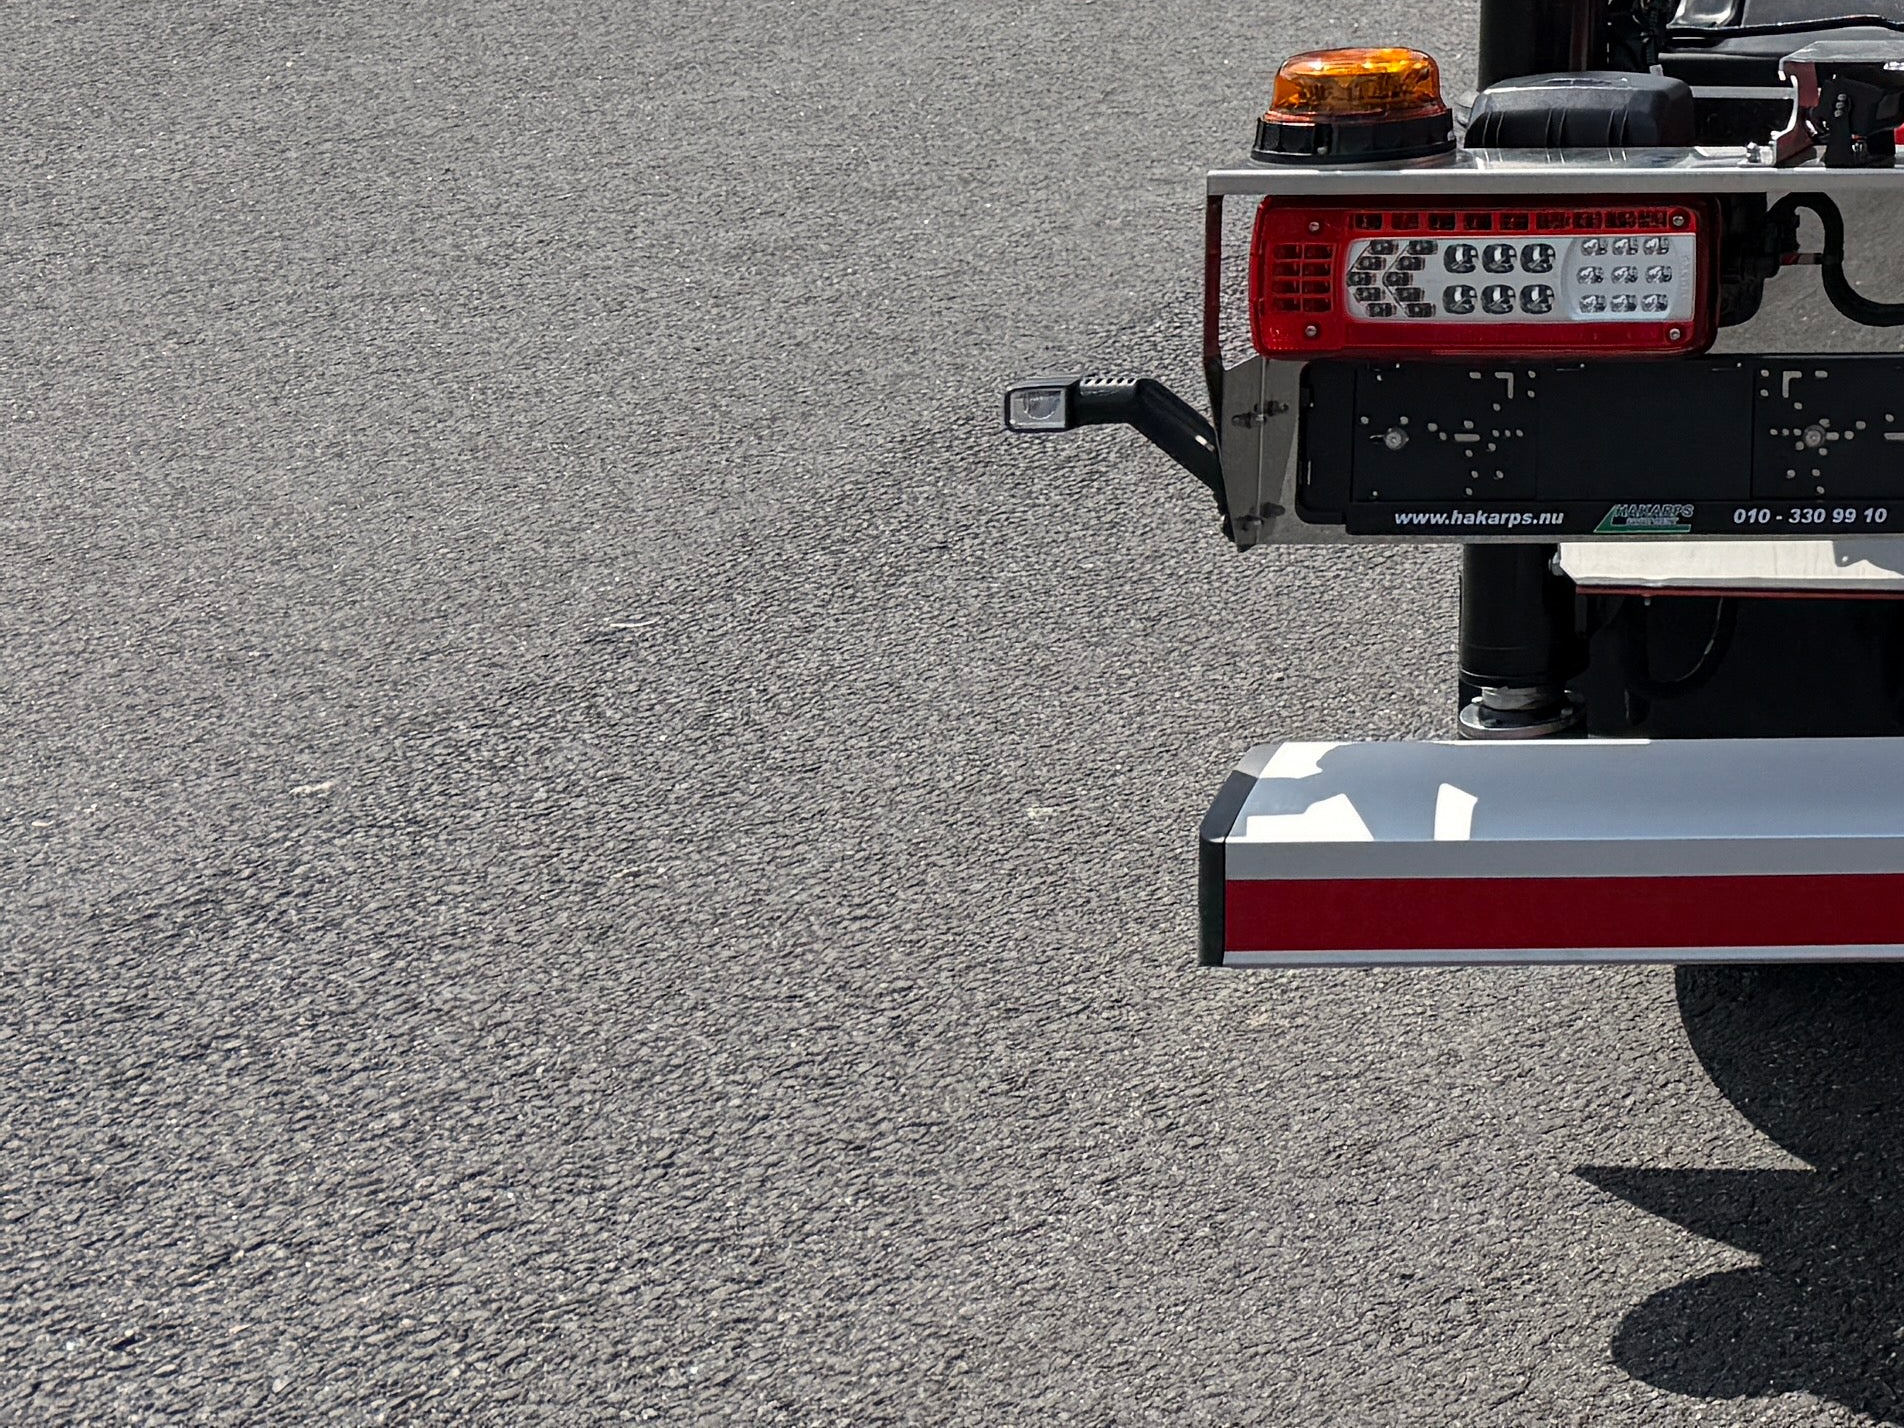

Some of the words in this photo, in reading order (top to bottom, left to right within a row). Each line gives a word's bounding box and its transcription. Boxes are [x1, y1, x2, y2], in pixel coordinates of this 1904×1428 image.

[1395, 509, 1565, 528] www.hakarps.nu
[1614, 504, 1695, 518] HAKARPS
[1733, 508, 1771, 524] 010
[1788, 508, 1826, 523] 330
[1832, 508, 1857, 523] 99
[1863, 507, 1888, 523] 10
